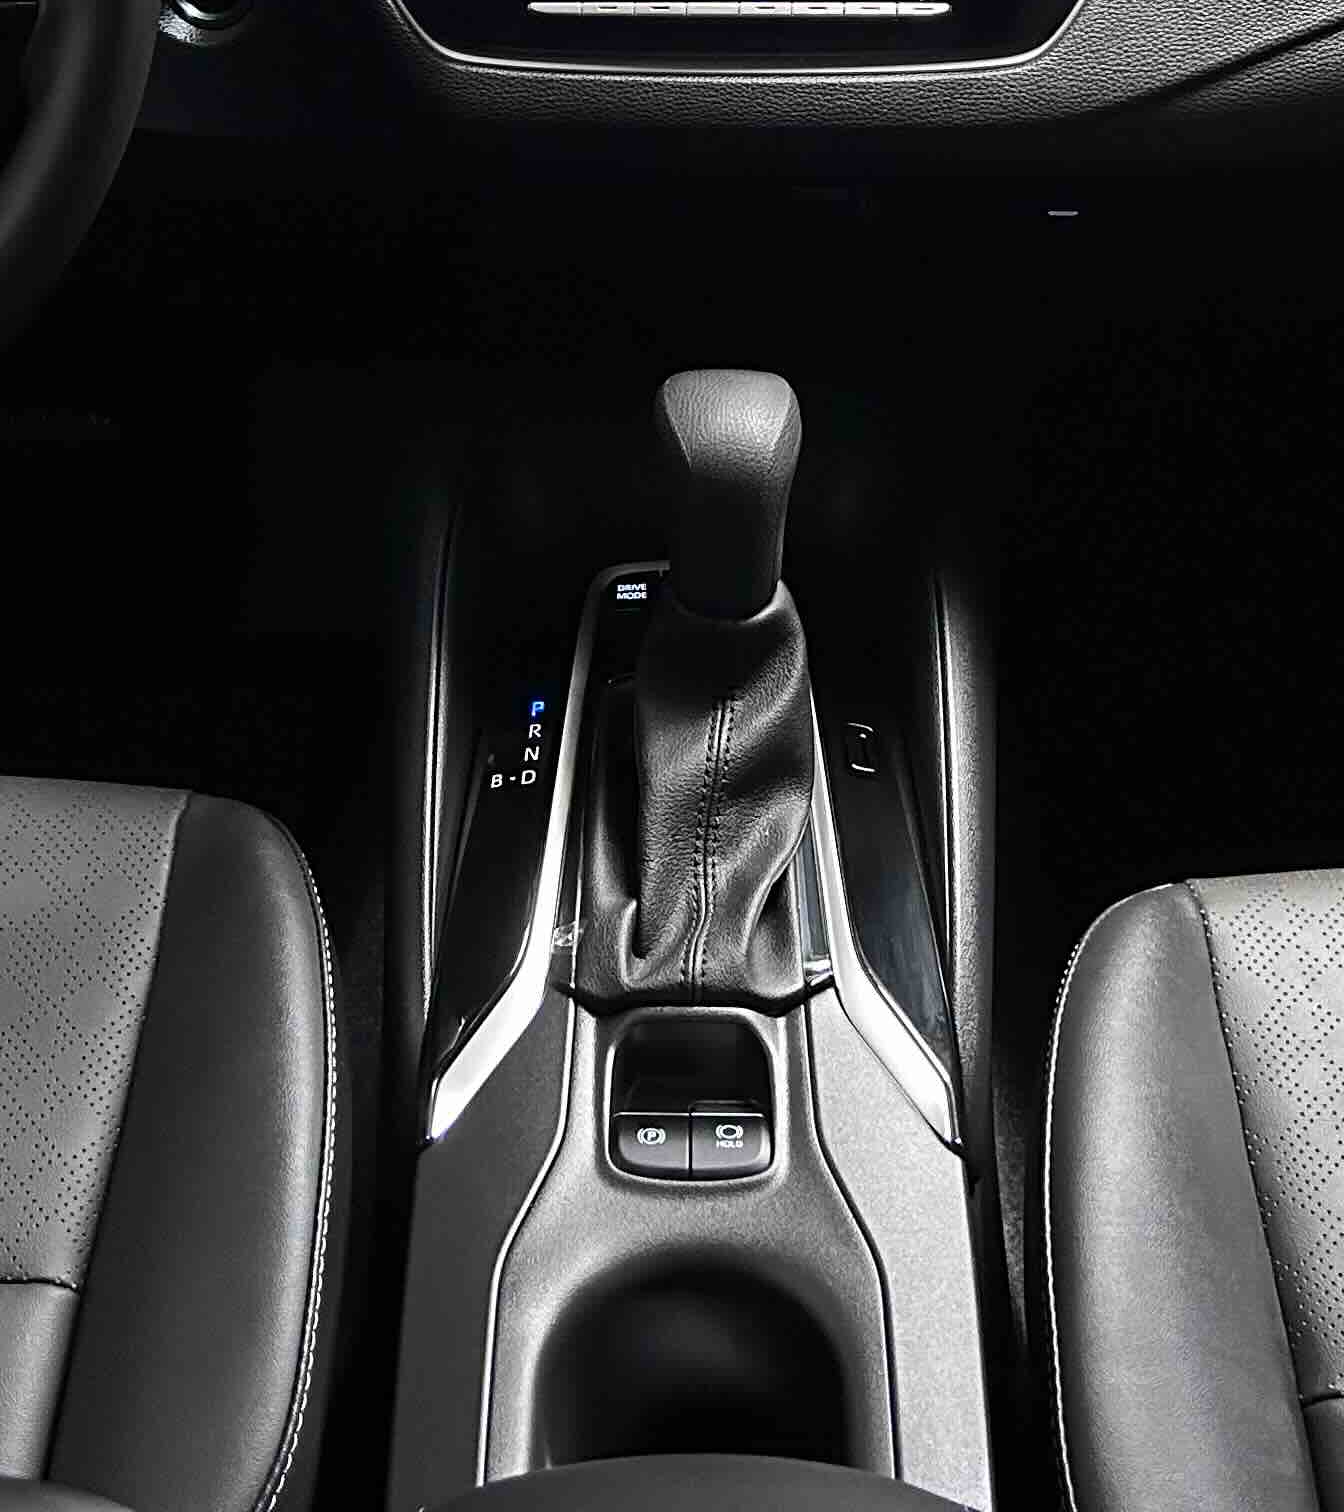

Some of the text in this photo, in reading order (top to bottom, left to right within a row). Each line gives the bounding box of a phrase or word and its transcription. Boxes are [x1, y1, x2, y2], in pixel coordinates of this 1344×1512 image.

[616, 591, 647, 600] MODE
[617, 583, 647, 592] DRIVE
[531, 701, 545, 717] P
[528, 723, 542, 739] R
[524, 745, 540, 762] N
[490, 769, 537, 789] B D
[716, 1140, 744, 1149] HOLD
